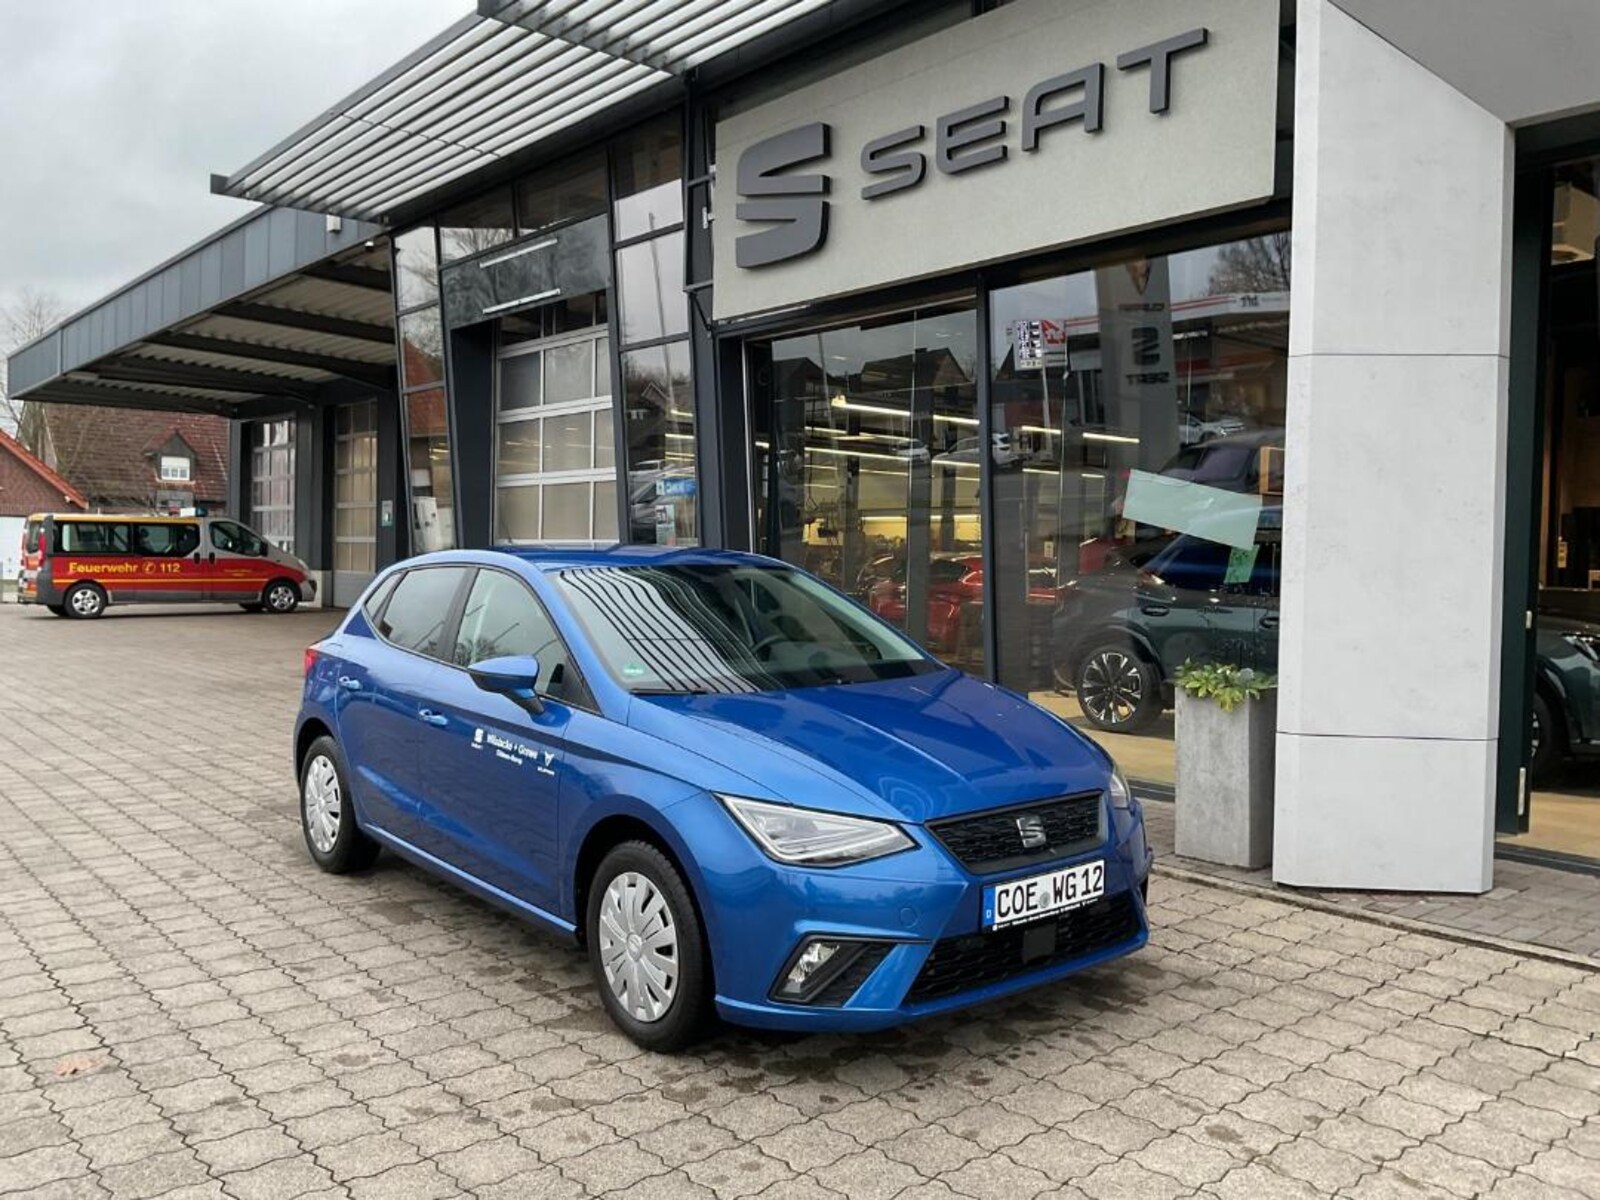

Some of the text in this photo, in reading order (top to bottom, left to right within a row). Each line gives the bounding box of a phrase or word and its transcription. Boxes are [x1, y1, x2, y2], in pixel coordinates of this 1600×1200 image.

[861, 28, 1208, 200] SEAT
[69, 562, 180, 573] Feuerwehr 112
[997, 882, 1038, 918] COE
